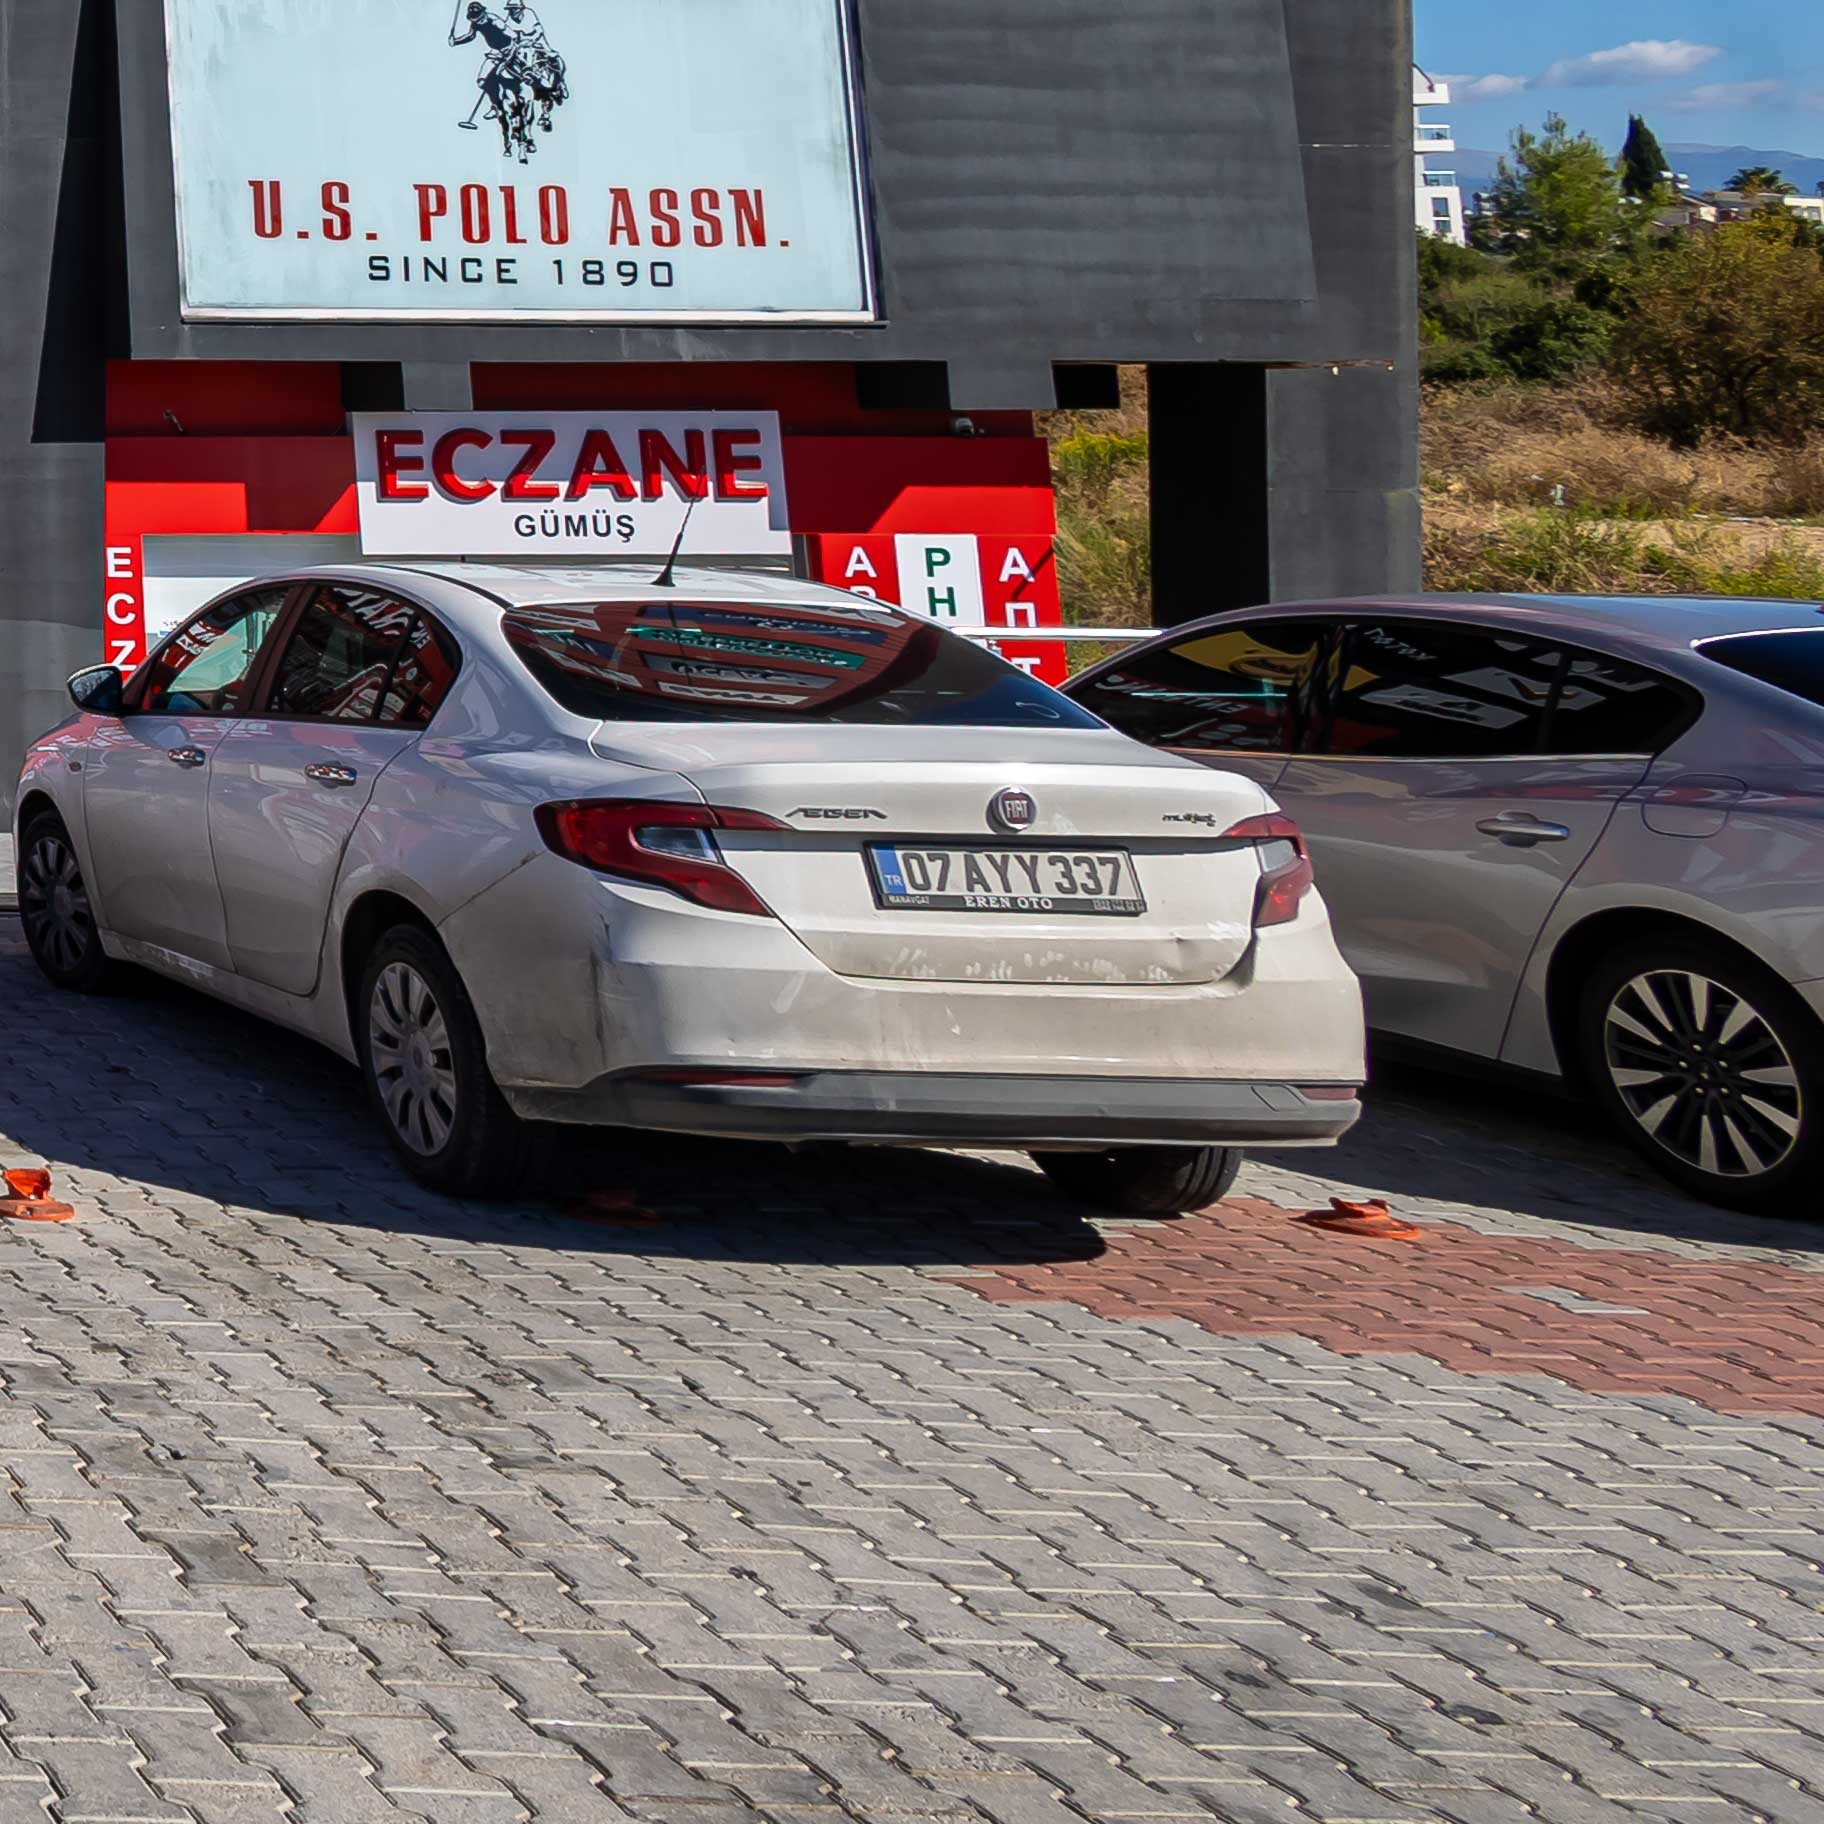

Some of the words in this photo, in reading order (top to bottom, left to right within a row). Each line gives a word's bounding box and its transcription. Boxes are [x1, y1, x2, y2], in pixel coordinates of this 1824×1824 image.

[248, 179, 378, 242] U.S.
[413, 183, 571, 246] POLO
[608, 187, 791, 248] ASSN.
[367, 254, 518, 286] SINCE
[552, 258, 674, 290] 1890
[377, 427, 769, 503] ECZANE
[512, 513, 636, 545] GÜMÜŞ
[1004, 800, 1029, 819] FIAT
[885, 874, 902, 887] TR
[902, 852, 951, 893] 07
[963, 853, 1043, 895] AYY
[1050, 855, 1122, 896] 337
[964, 896, 1011, 909] EREN
[1017, 896, 1053, 909] OTO
